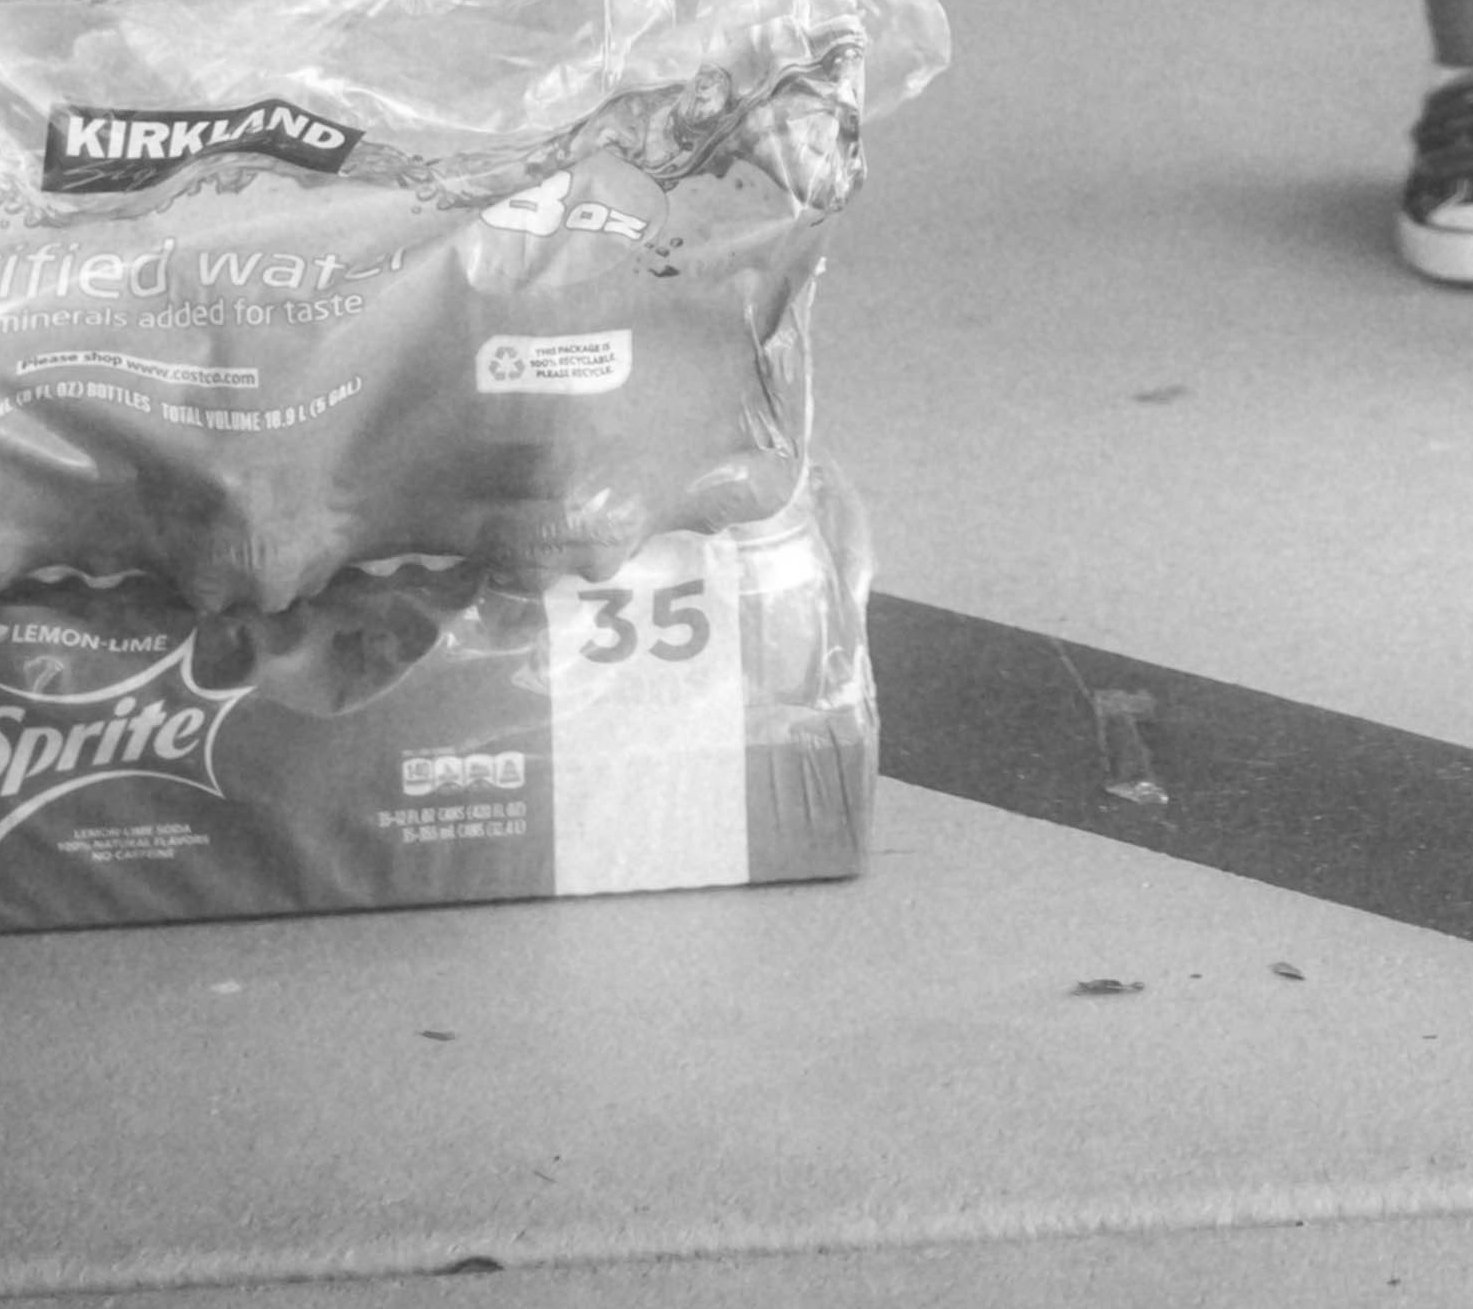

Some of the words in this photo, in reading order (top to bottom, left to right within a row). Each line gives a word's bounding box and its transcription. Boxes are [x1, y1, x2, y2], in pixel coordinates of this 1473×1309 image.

[64, 105, 346, 161] KIRKLAND
[138, 298, 225, 329] added
[233, 297, 275, 326] for
[285, 293, 364, 325] taste
[21, 352, 80, 370] Please
[84, 349, 124, 367] shop
[87, 381, 152, 414] BOTTLES
[161, 402, 204, 428] TOTAL
[204, 409, 262, 431] VOLUME
[12, 624, 168, 652] LEMON-LIME
[577, 578, 712, 664] 35
